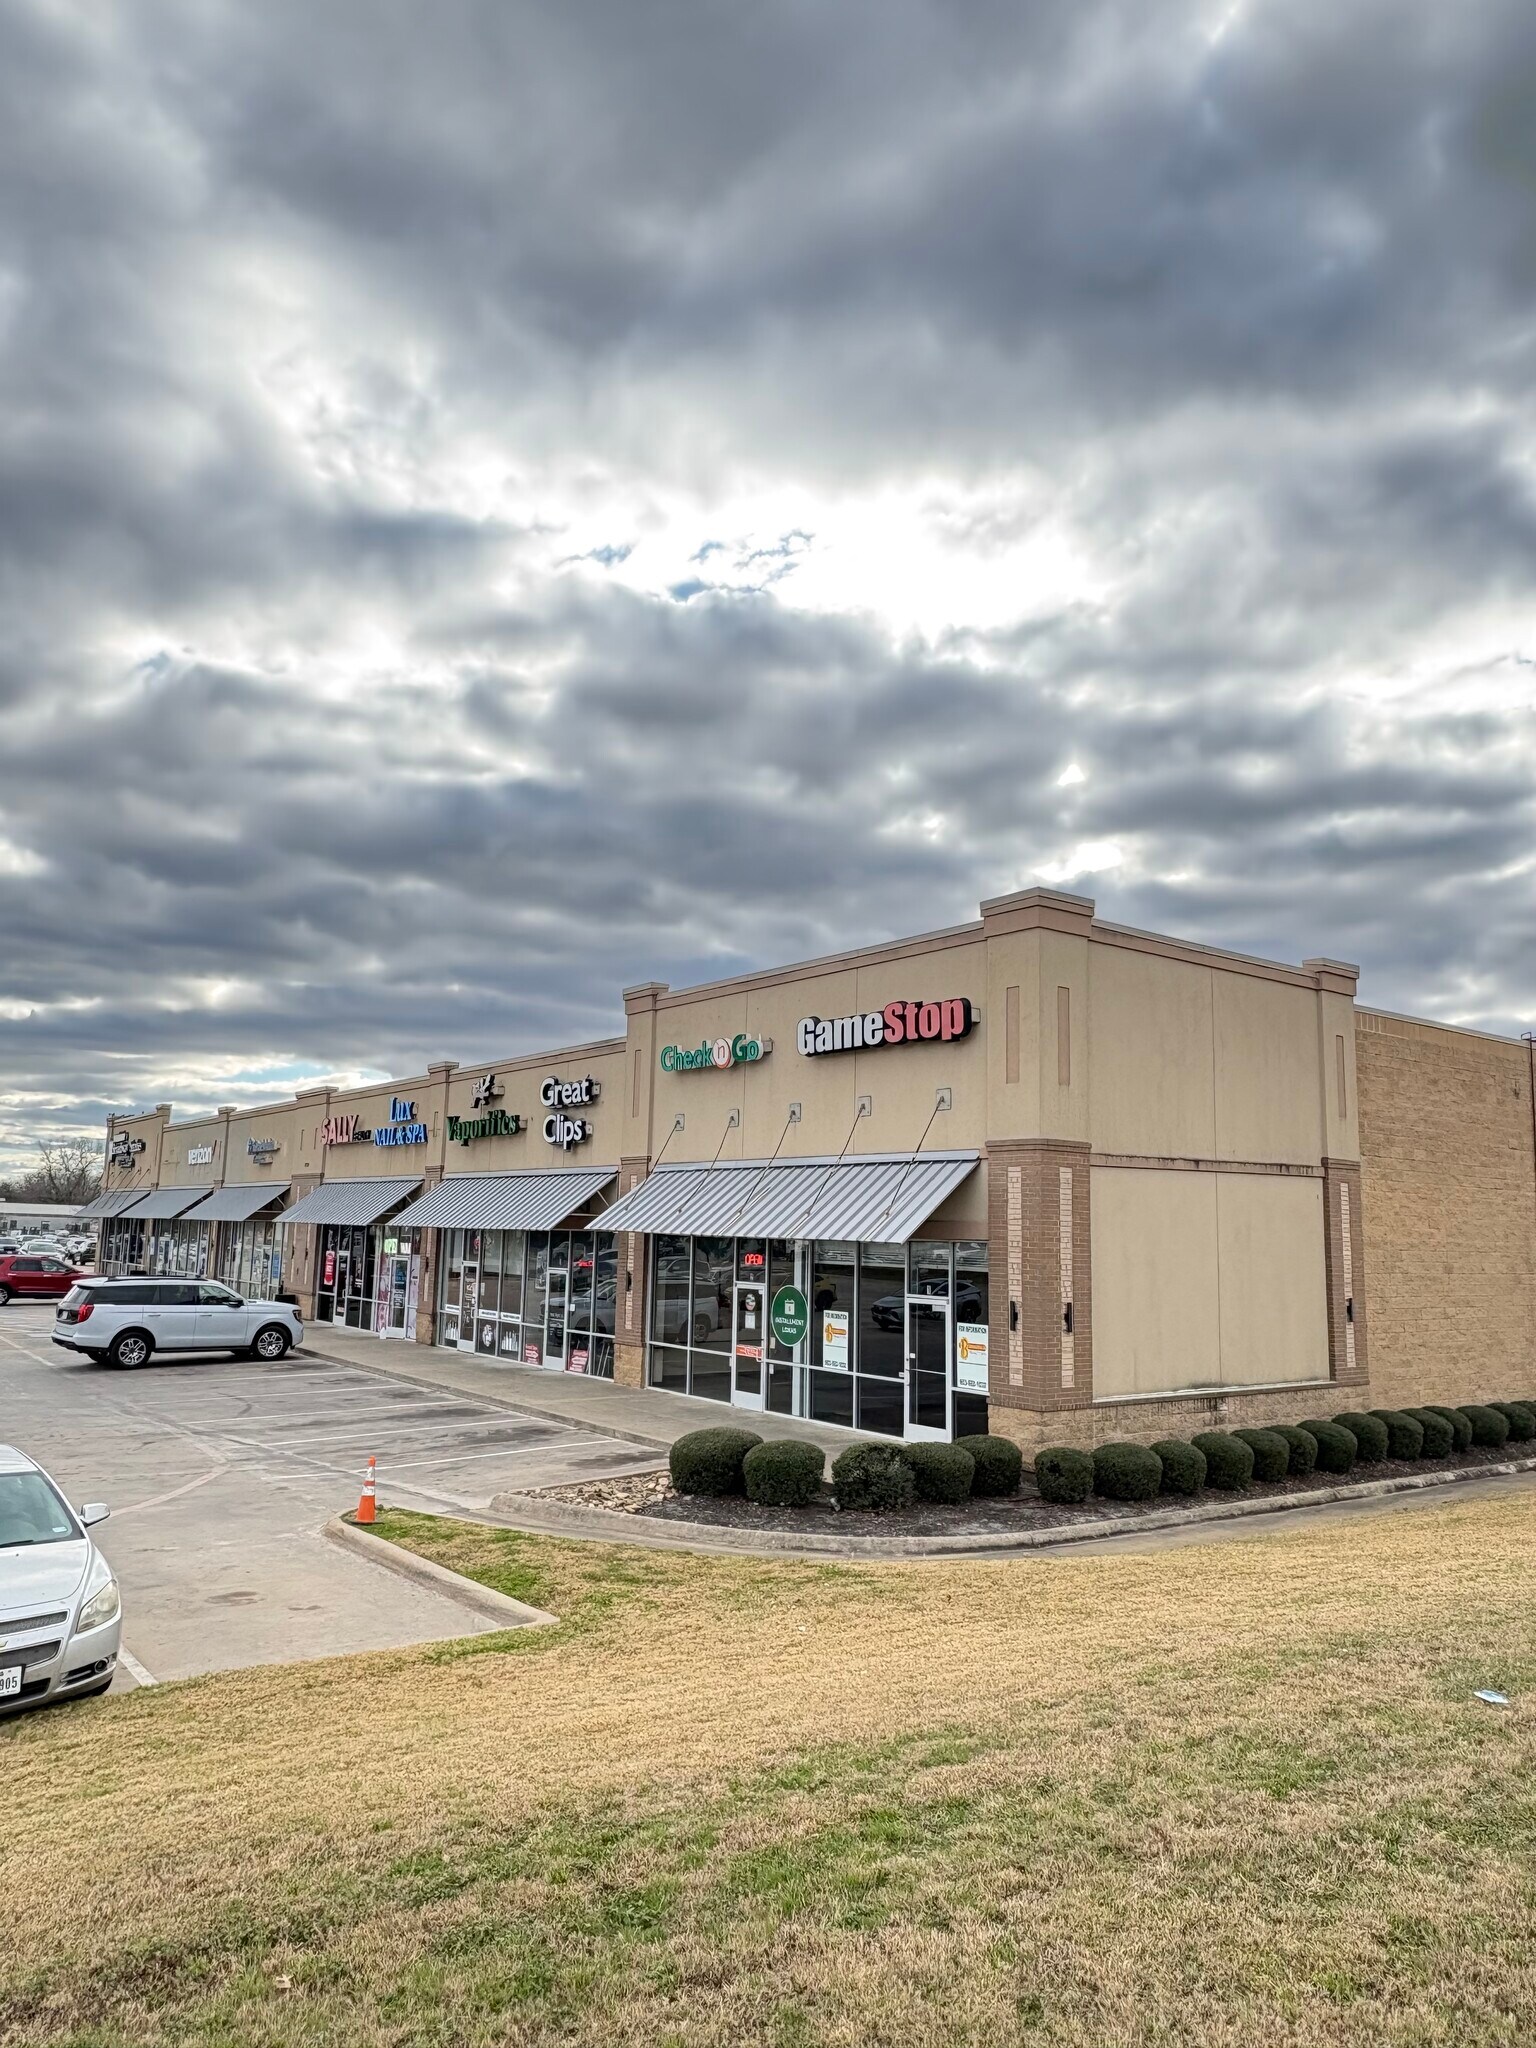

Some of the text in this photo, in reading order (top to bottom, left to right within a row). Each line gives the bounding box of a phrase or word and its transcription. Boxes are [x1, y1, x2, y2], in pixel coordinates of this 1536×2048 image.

[797, 998, 971, 1056] GameStop
[660, 1040, 714, 1072] Check
[731, 1033, 763, 1062] Go
[540, 1076, 593, 1107] Great
[389, 1097, 415, 1122] Lux
[321, 1115, 359, 1145] SALLY
[374, 1127, 398, 1147] NAIL
[406, 1123, 428, 1144] SPA
[543, 1113, 586, 1151] Clips
